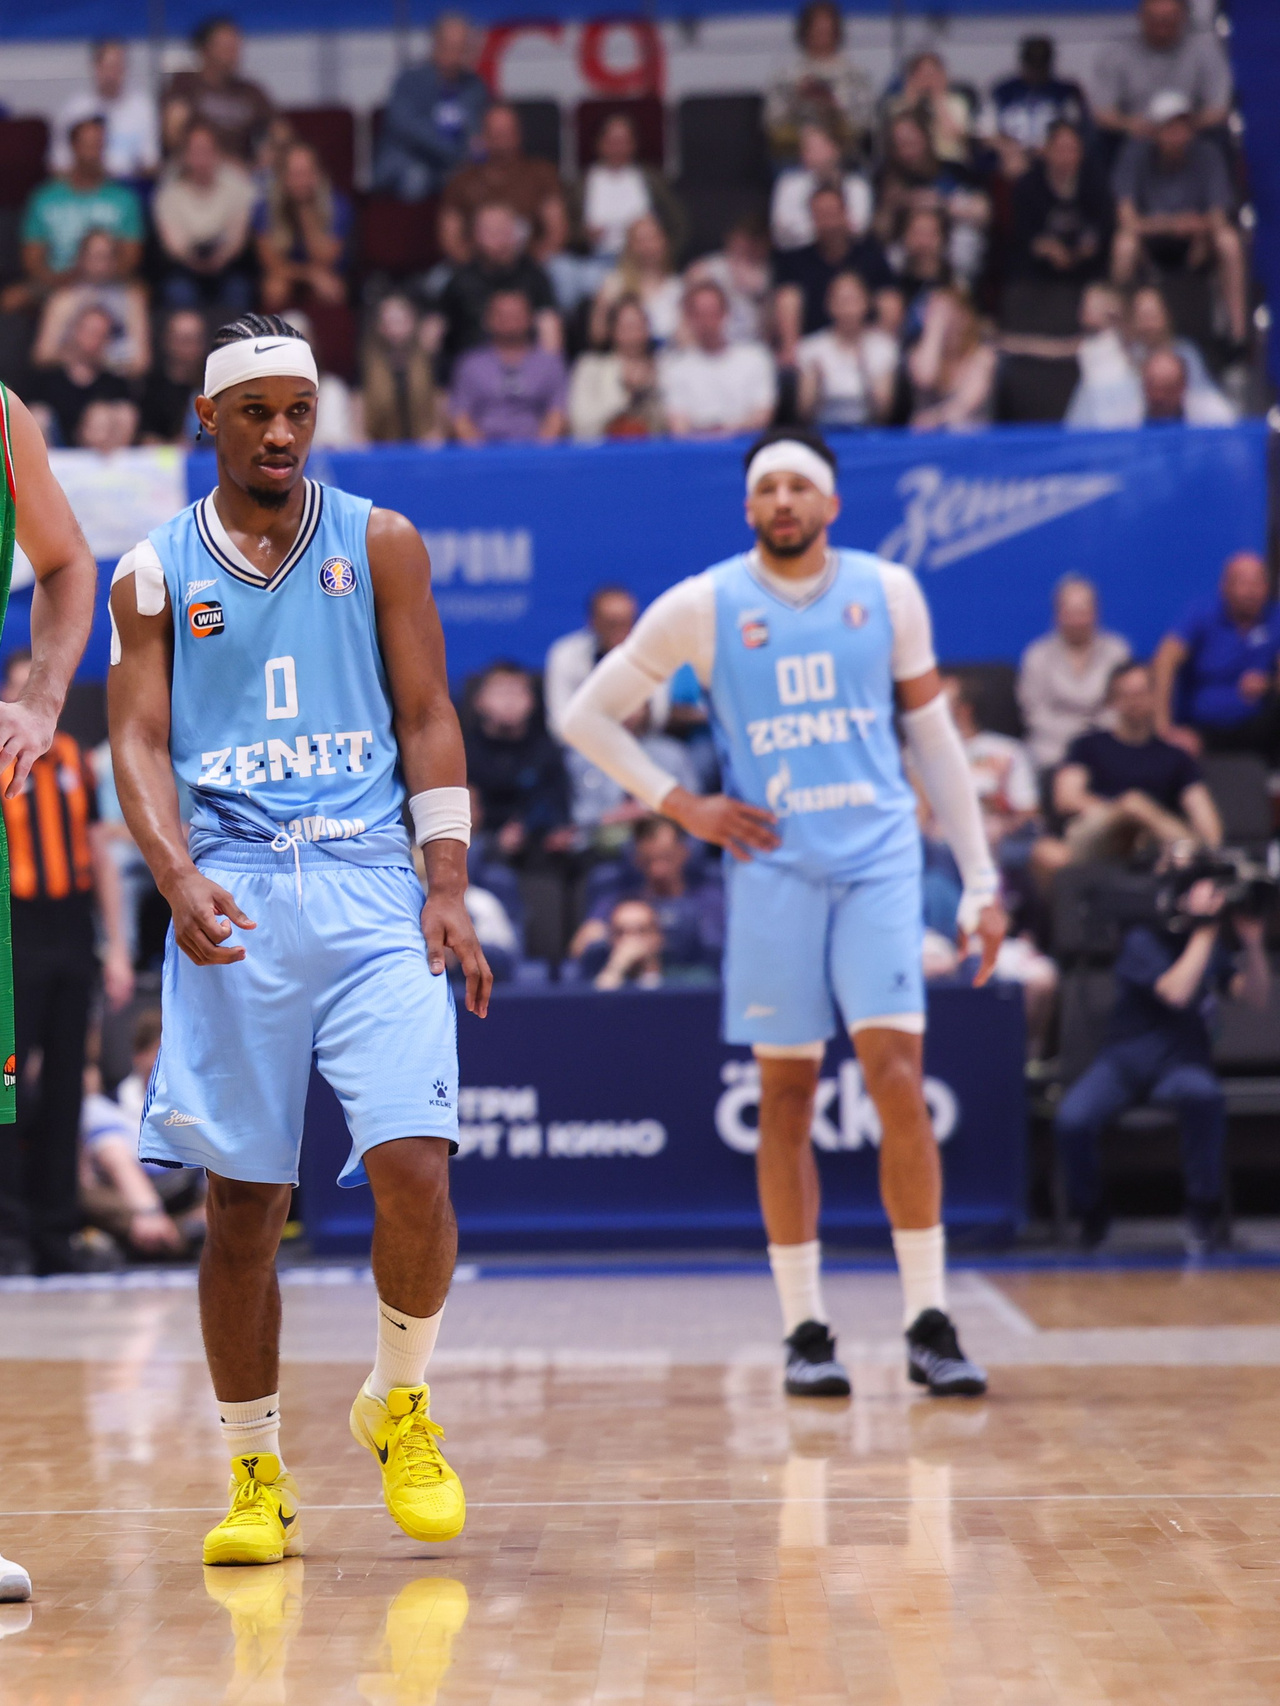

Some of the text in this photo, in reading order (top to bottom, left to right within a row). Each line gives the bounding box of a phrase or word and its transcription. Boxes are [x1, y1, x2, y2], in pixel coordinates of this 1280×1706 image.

[197, 611, 222, 626] WIN
[265, 655, 299, 721] 0
[776, 651, 836, 705] 00
[747, 708, 876, 756] ZENIT
[197, 730, 373, 786] ZENIT
[458, 1084, 538, 1121] ТРИ
